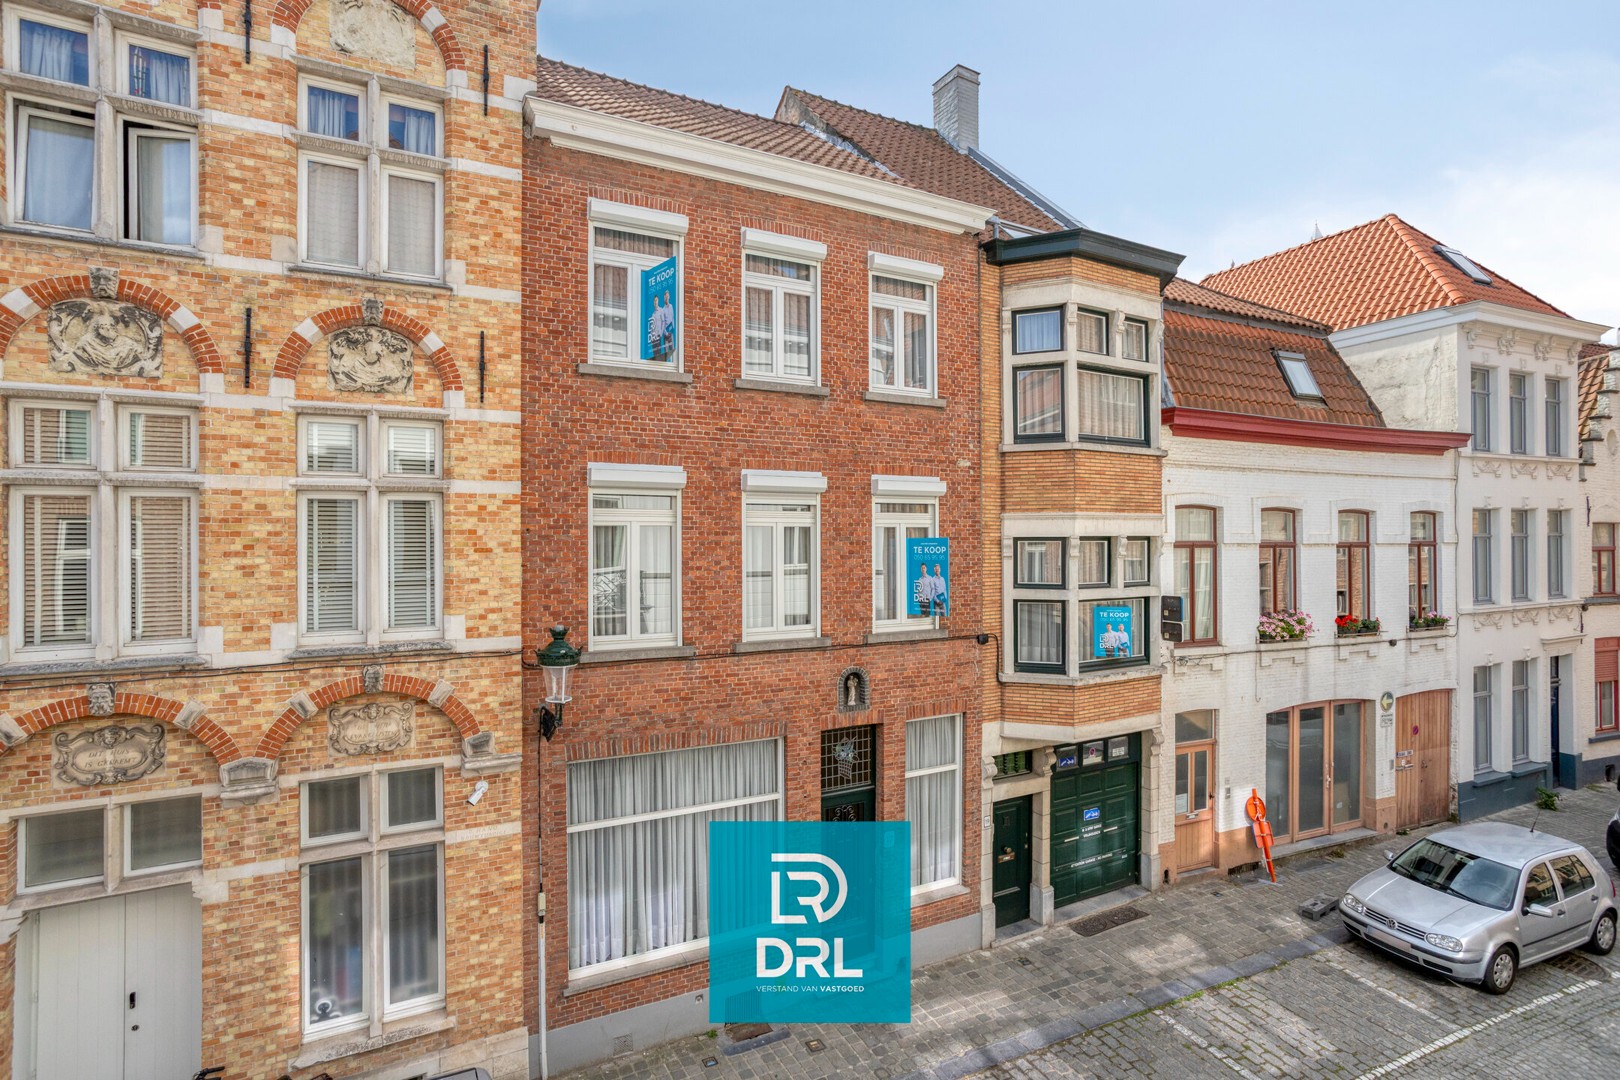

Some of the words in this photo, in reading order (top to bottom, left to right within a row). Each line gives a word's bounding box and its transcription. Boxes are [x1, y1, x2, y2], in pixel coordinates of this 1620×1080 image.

[648, 276, 656, 287] TE
[656, 267, 675, 283] KOOP
[913, 546, 923, 554] TE
[924, 546, 947, 554] KOOP
[914, 593, 930, 602] DRL
